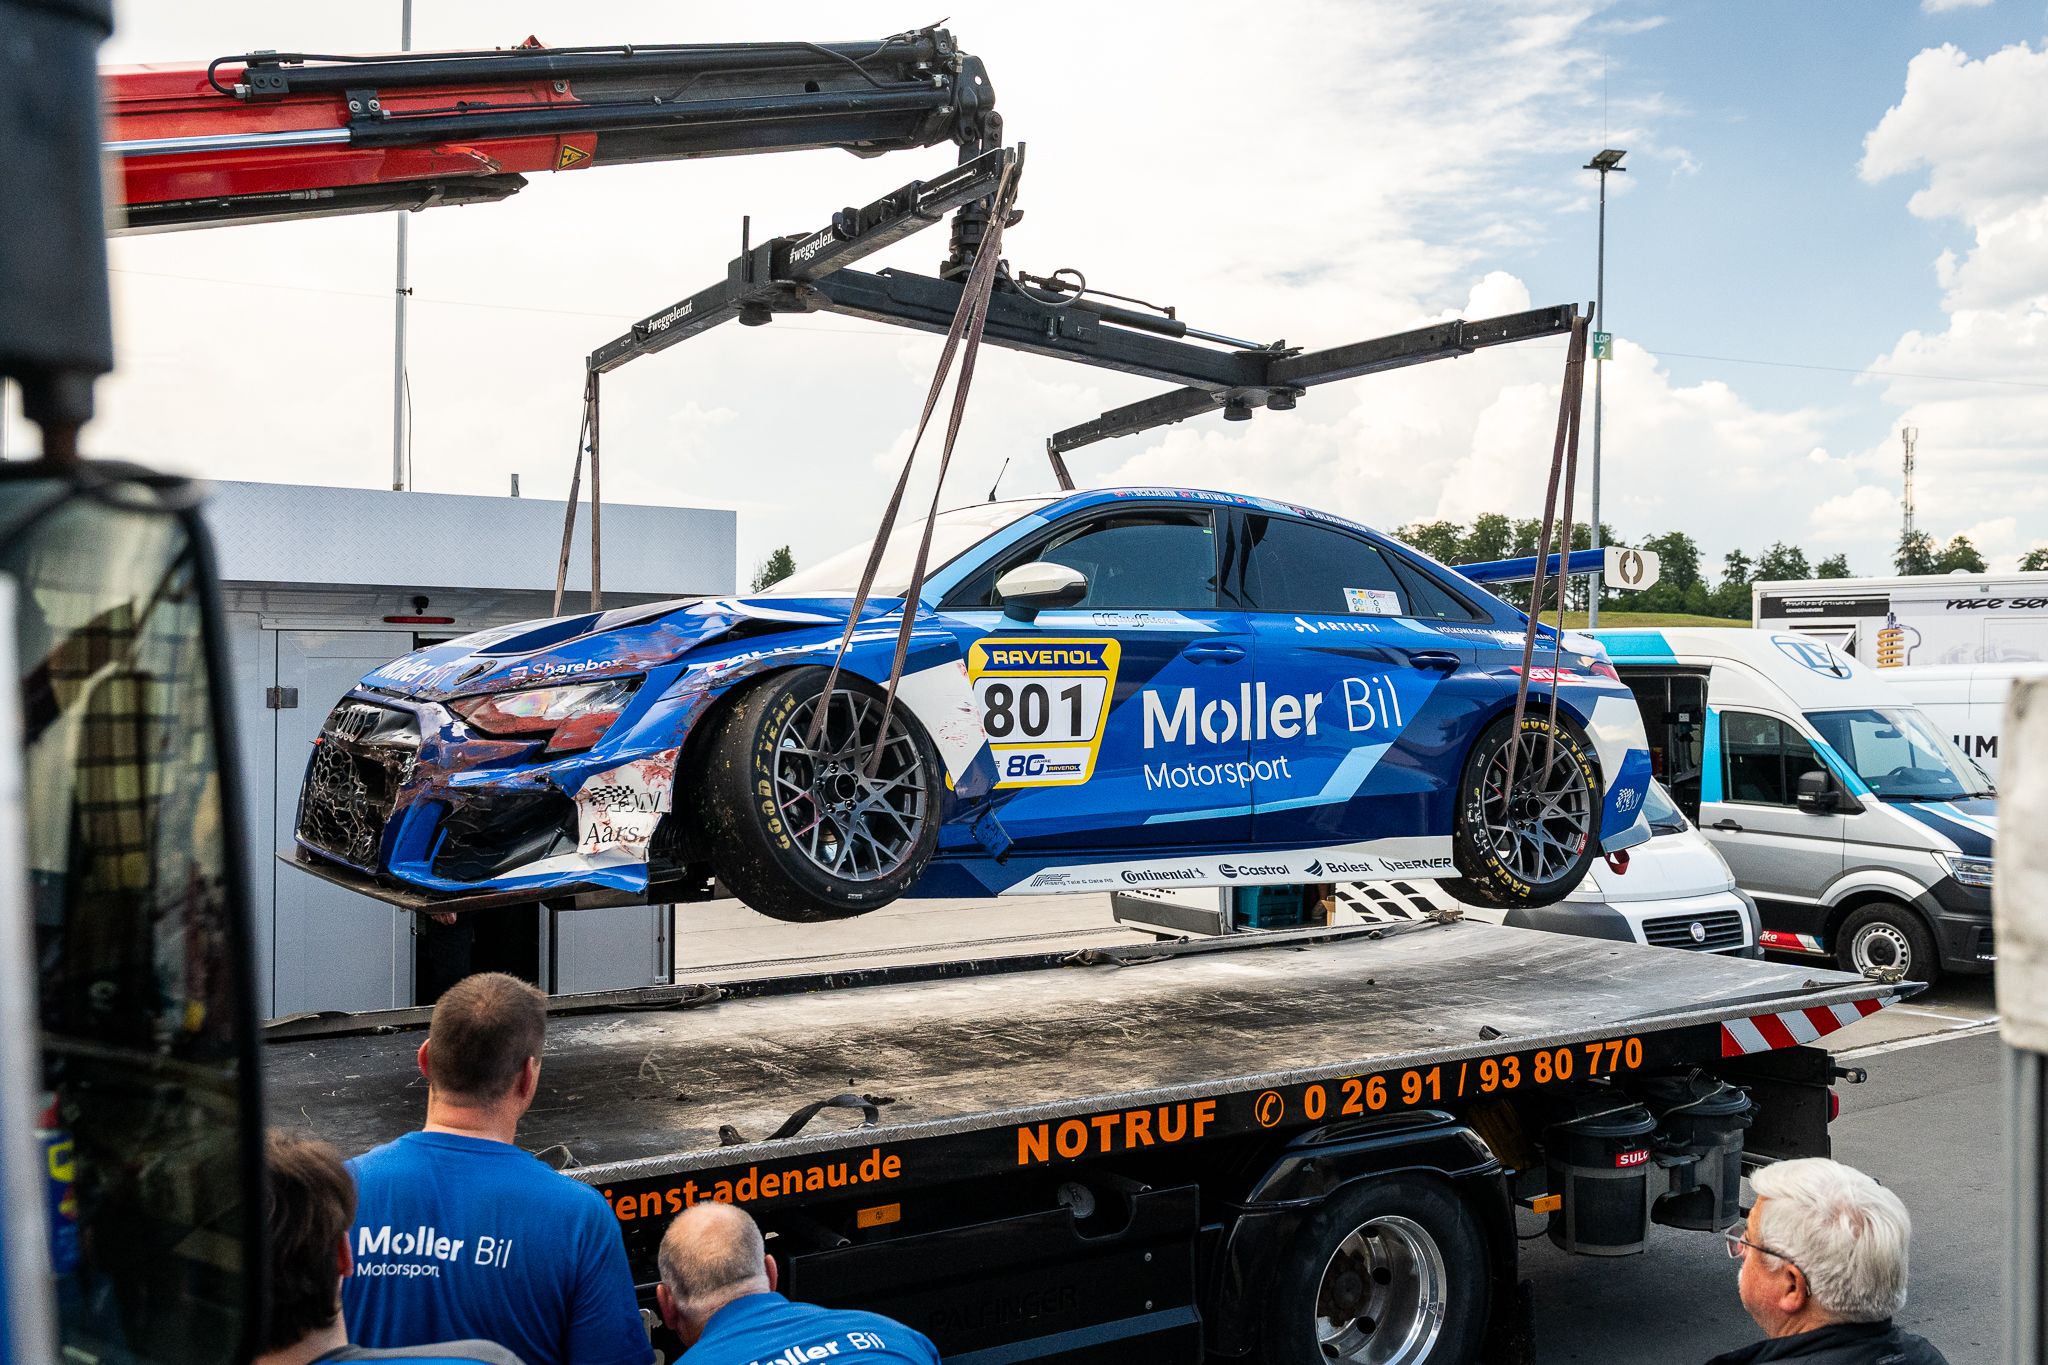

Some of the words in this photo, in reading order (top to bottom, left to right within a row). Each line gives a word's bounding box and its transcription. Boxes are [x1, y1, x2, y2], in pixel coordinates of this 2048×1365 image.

[647, 299, 693, 334] #weggelenzt
[1594, 334, 1611, 344] LOP
[1598, 345, 1606, 359] 2
[1946, 598, 2004, 610] race
[1317, 621, 1381, 633] ARTISTI
[1436, 626, 1489, 635] VOLKSWAGEN
[992, 649, 1099, 665] RAVENOL
[531, 658, 622, 677] Sharebox
[983, 683, 1082, 738] 801
[1342, 675, 1403, 732] Bil
[1006, 754, 1046, 777] 80
[1143, 755, 1292, 791] Motorsport
[1238, 864, 1291, 876] Castrol
[1326, 861, 1374, 874] Bolest
[1395, 857, 1452, 871] BERNER
[1121, 868, 1195, 884] Continental
[1485, 855, 1532, 898] EAGLE
[1017, 1099, 1216, 1165] NOTRUF
[1303, 1084, 1327, 1120] 0
[1341, 1075, 1388, 1115] 26
[1401, 1066, 1441, 1105] 91
[1479, 1055, 1522, 1092] 93
[1533, 1047, 1574, 1084] 80
[1585, 1037, 1644, 1076] 770
[474, 1235, 513, 1269] Bil
[356, 1262, 440, 1279] Motorsport
[846, 1332, 887, 1350] Bil
